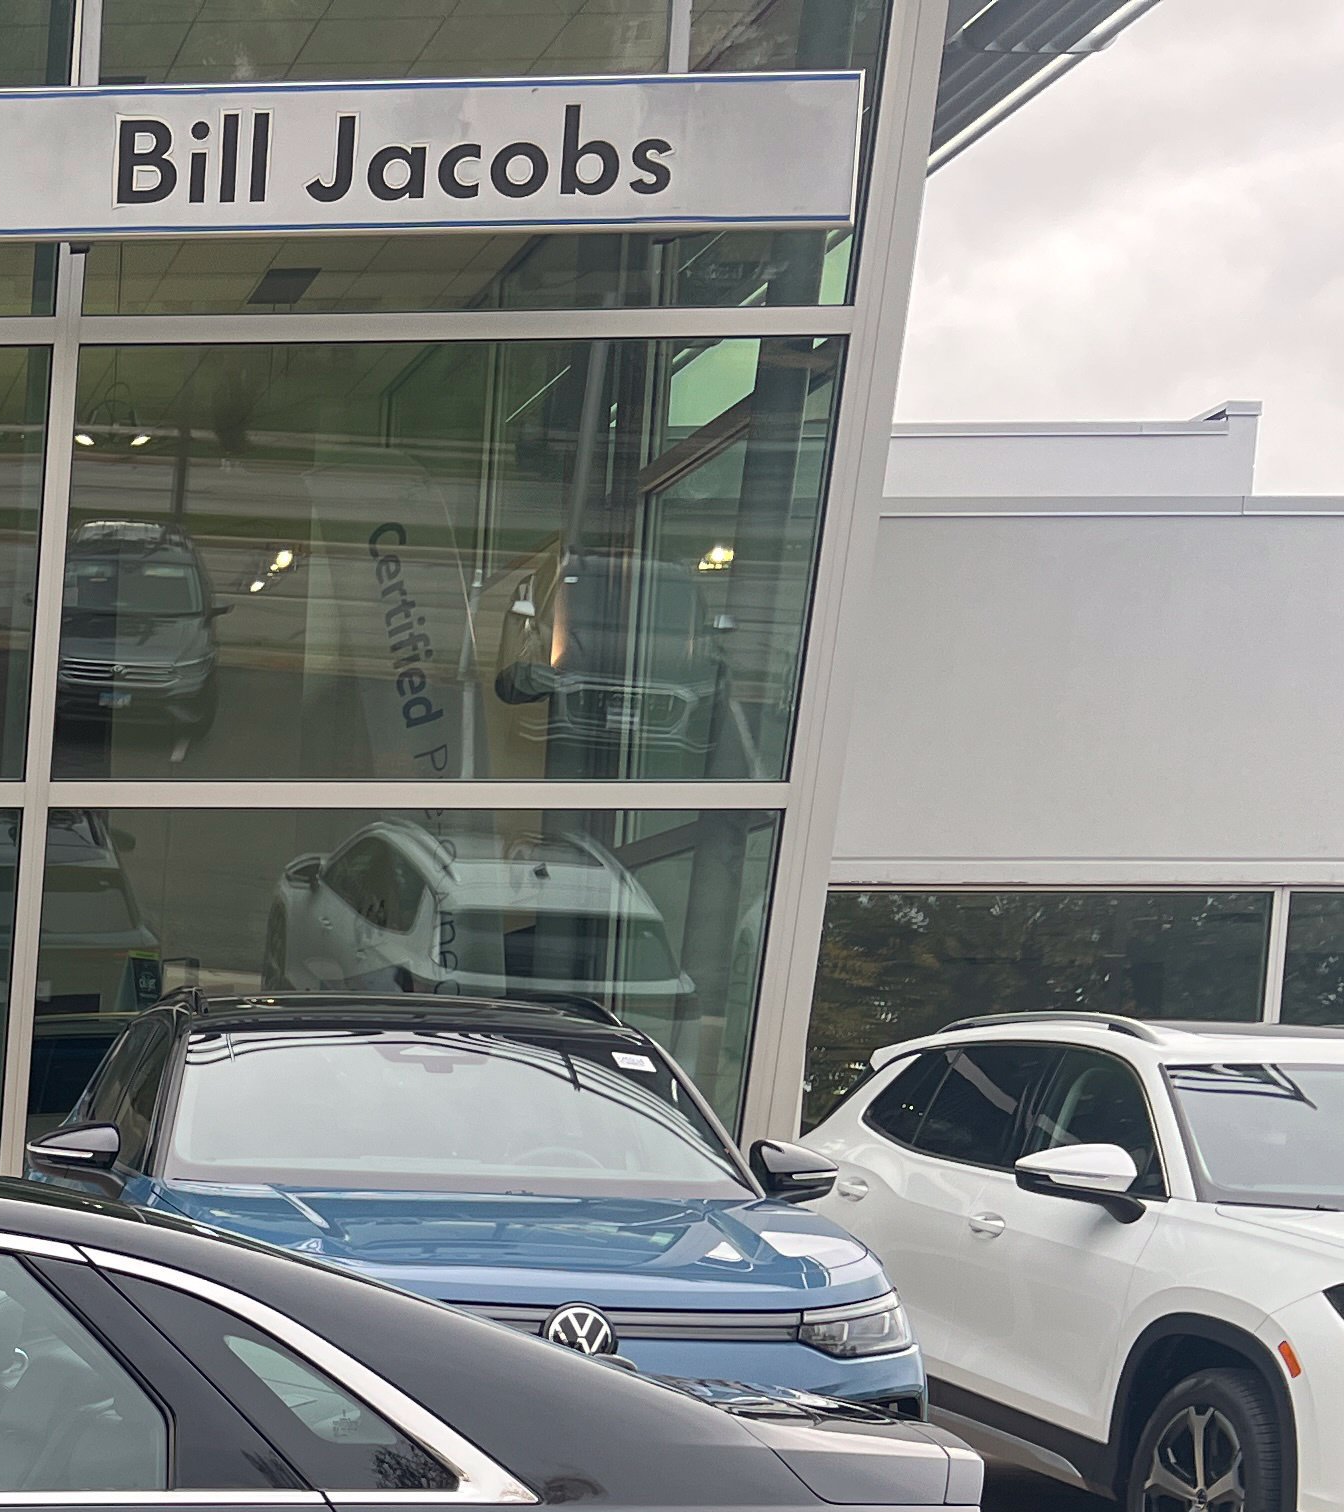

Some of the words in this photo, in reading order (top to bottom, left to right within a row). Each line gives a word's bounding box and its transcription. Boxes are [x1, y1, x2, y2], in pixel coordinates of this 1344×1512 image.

[115, 109, 269, 207] Bill
[305, 103, 673, 203] Jacobs
[368, 521, 444, 729] Certified
